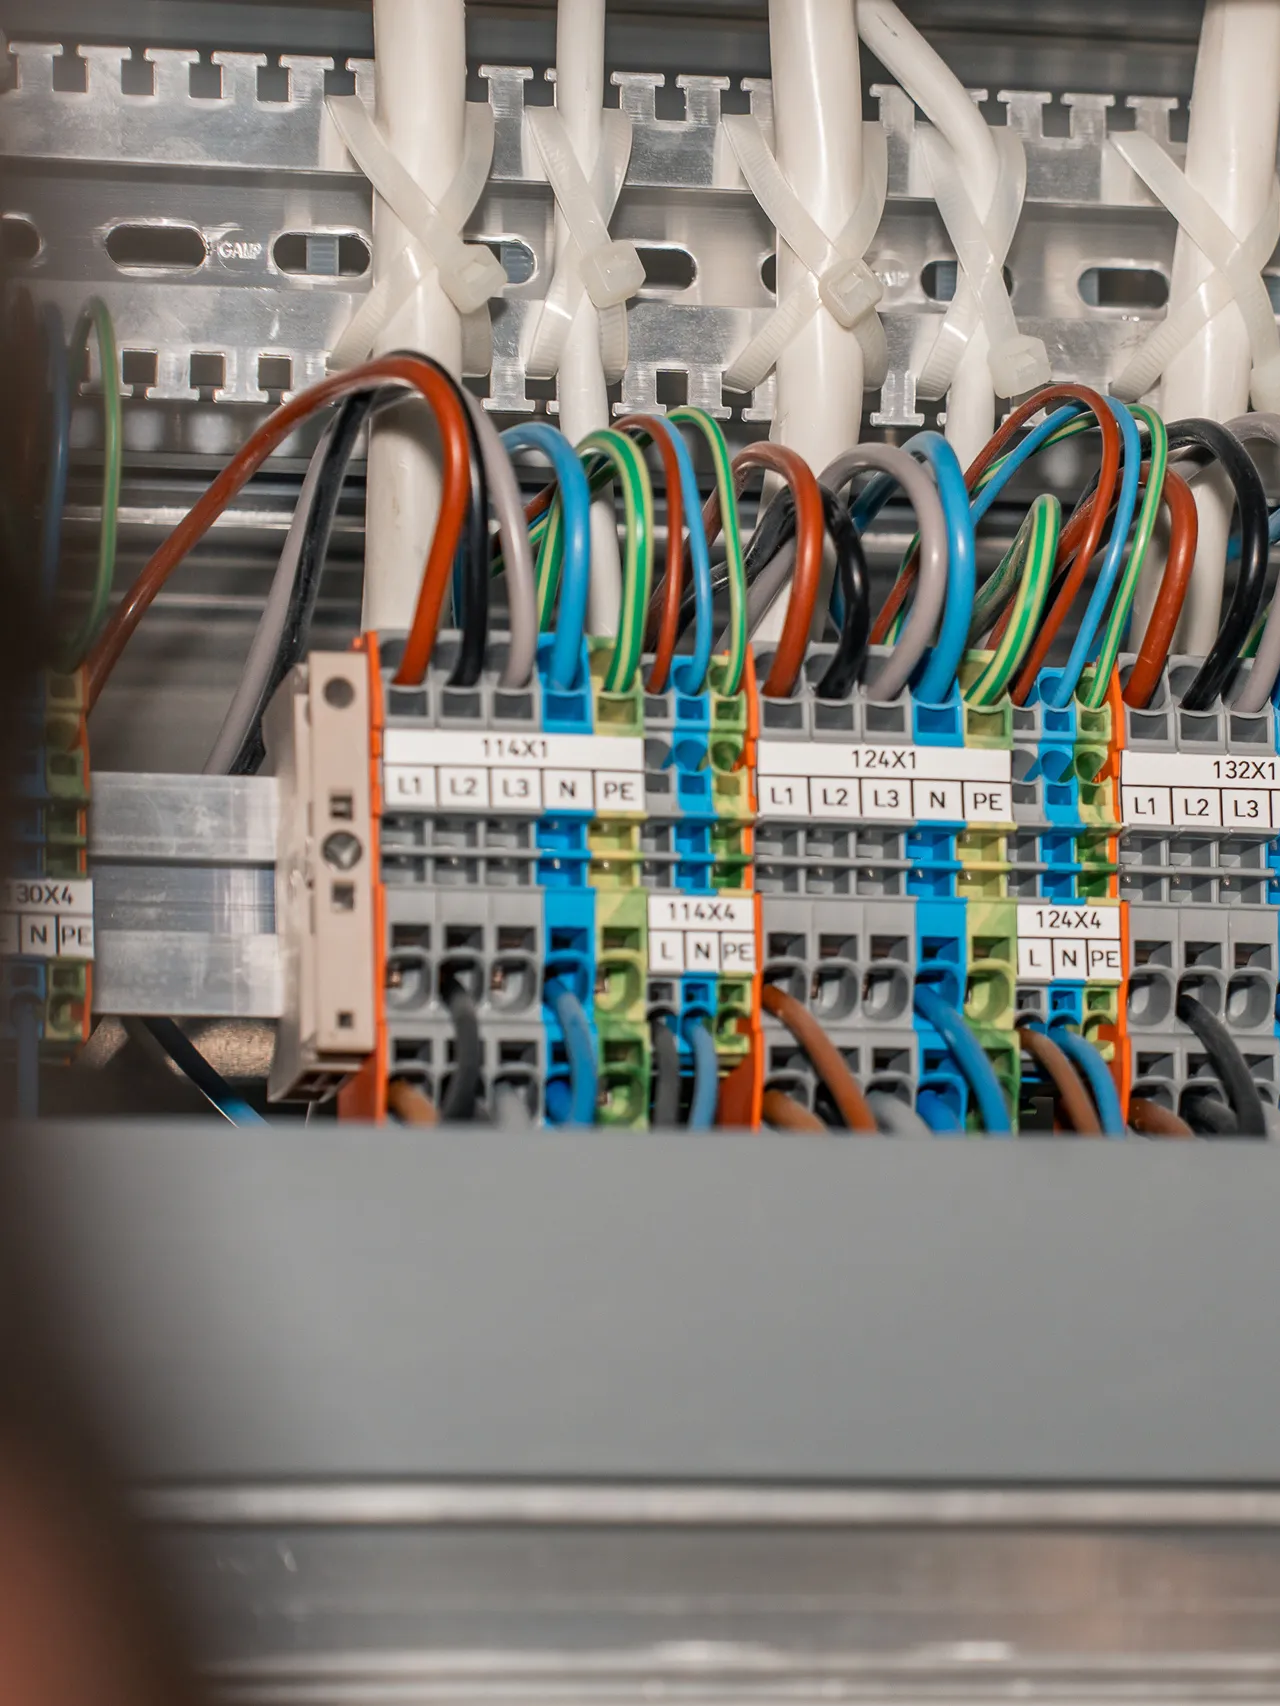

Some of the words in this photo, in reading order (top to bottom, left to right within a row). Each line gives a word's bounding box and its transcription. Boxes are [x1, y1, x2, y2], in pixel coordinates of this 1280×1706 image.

[482, 739, 549, 758] 114X1
[852, 749, 917, 769] 124X1
[1213, 760, 1276, 781] 132X1
[397, 776, 421, 795] L1
[449, 777, 477, 797] L2
[502, 778, 530, 799] L3
[559, 780, 577, 799] N
[603, 782, 635, 801] PE
[771, 787, 793, 805] L1
[822, 788, 848, 807] L2
[873, 789, 899, 809] L3
[930, 791, 946, 810] N
[973, 792, 1003, 812] PE
[1134, 796, 1156, 815] L1
[1184, 798, 1209, 818] L2
[1233, 799, 1259, 819] L3
[667, 902, 737, 922] 114X4
[1036, 910, 1102, 930] 124X4
[29, 923, 48, 945] N
[659, 941, 673, 960] L
[693, 942, 711, 961] N
[722, 942, 753, 962] PE
[1029, 949, 1042, 967] L
[1062, 949, 1077, 967] N
[1091, 950, 1120, 968] PE
